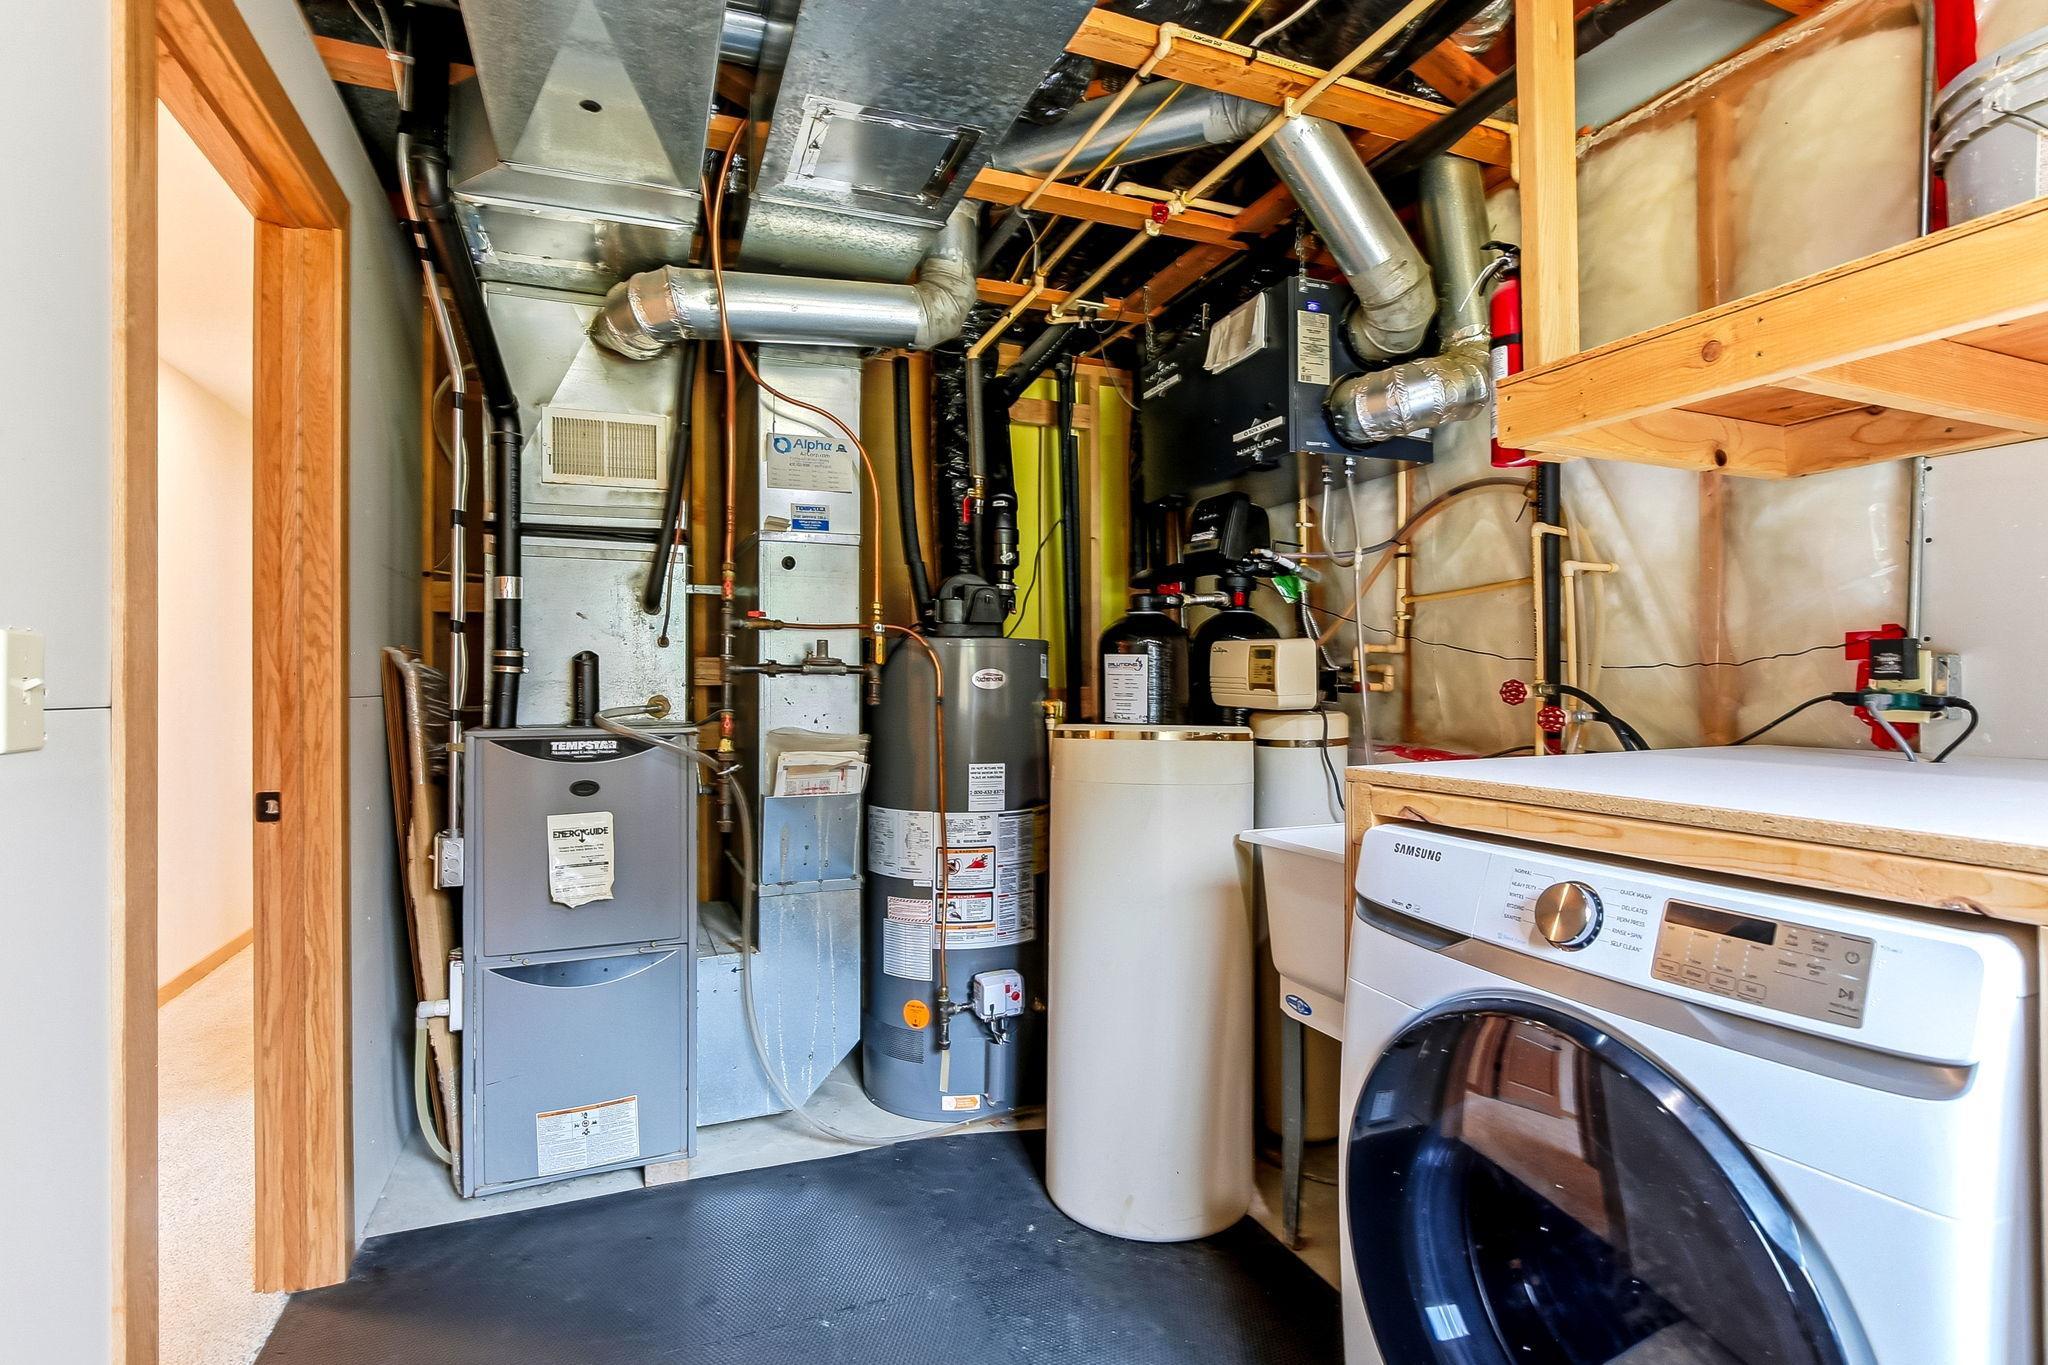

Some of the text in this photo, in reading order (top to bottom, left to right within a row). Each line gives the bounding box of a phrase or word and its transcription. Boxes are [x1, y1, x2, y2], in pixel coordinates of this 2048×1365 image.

[793, 438, 832, 453] Alpha
[550, 740, 617, 751] TEMPSTAR
[1394, 842, 1442, 862] SAMSUNG
[1619, 889, 1635, 897] QUICK
[1621, 904, 1648, 915] DELICATES
